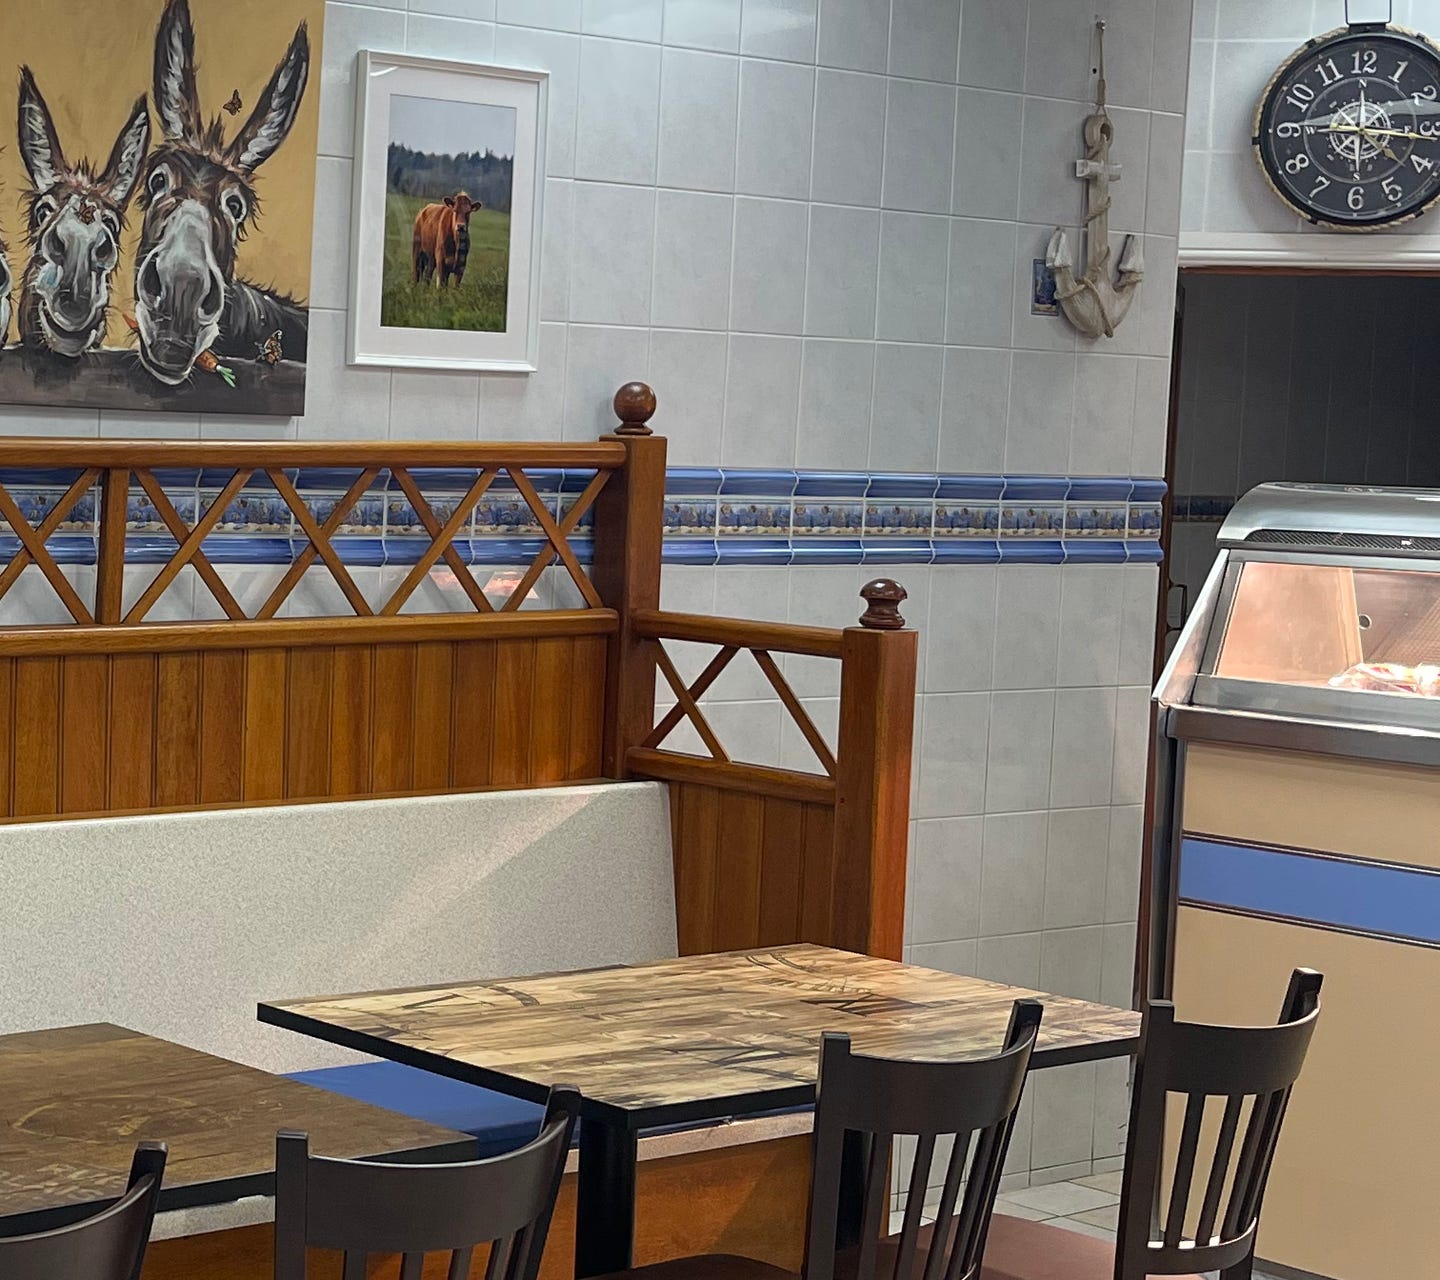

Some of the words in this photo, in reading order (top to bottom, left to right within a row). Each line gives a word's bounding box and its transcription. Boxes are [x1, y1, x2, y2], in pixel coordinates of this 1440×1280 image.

[1314, 58, 1344, 87] 11
[1350, 50, 1378, 75] 12
[1387, 60, 1409, 84] 1
[1286, 83, 1315, 113] 10
[1410, 84, 1438, 107] 2
[1276, 121, 1302, 139] 9
[1285, 153, 1310, 175] 8
[1410, 153, 1434, 174] 4
[1309, 175, 1331, 198] 7
[1347, 186, 1365, 210] 6
[1381, 176, 1403, 202] 5
